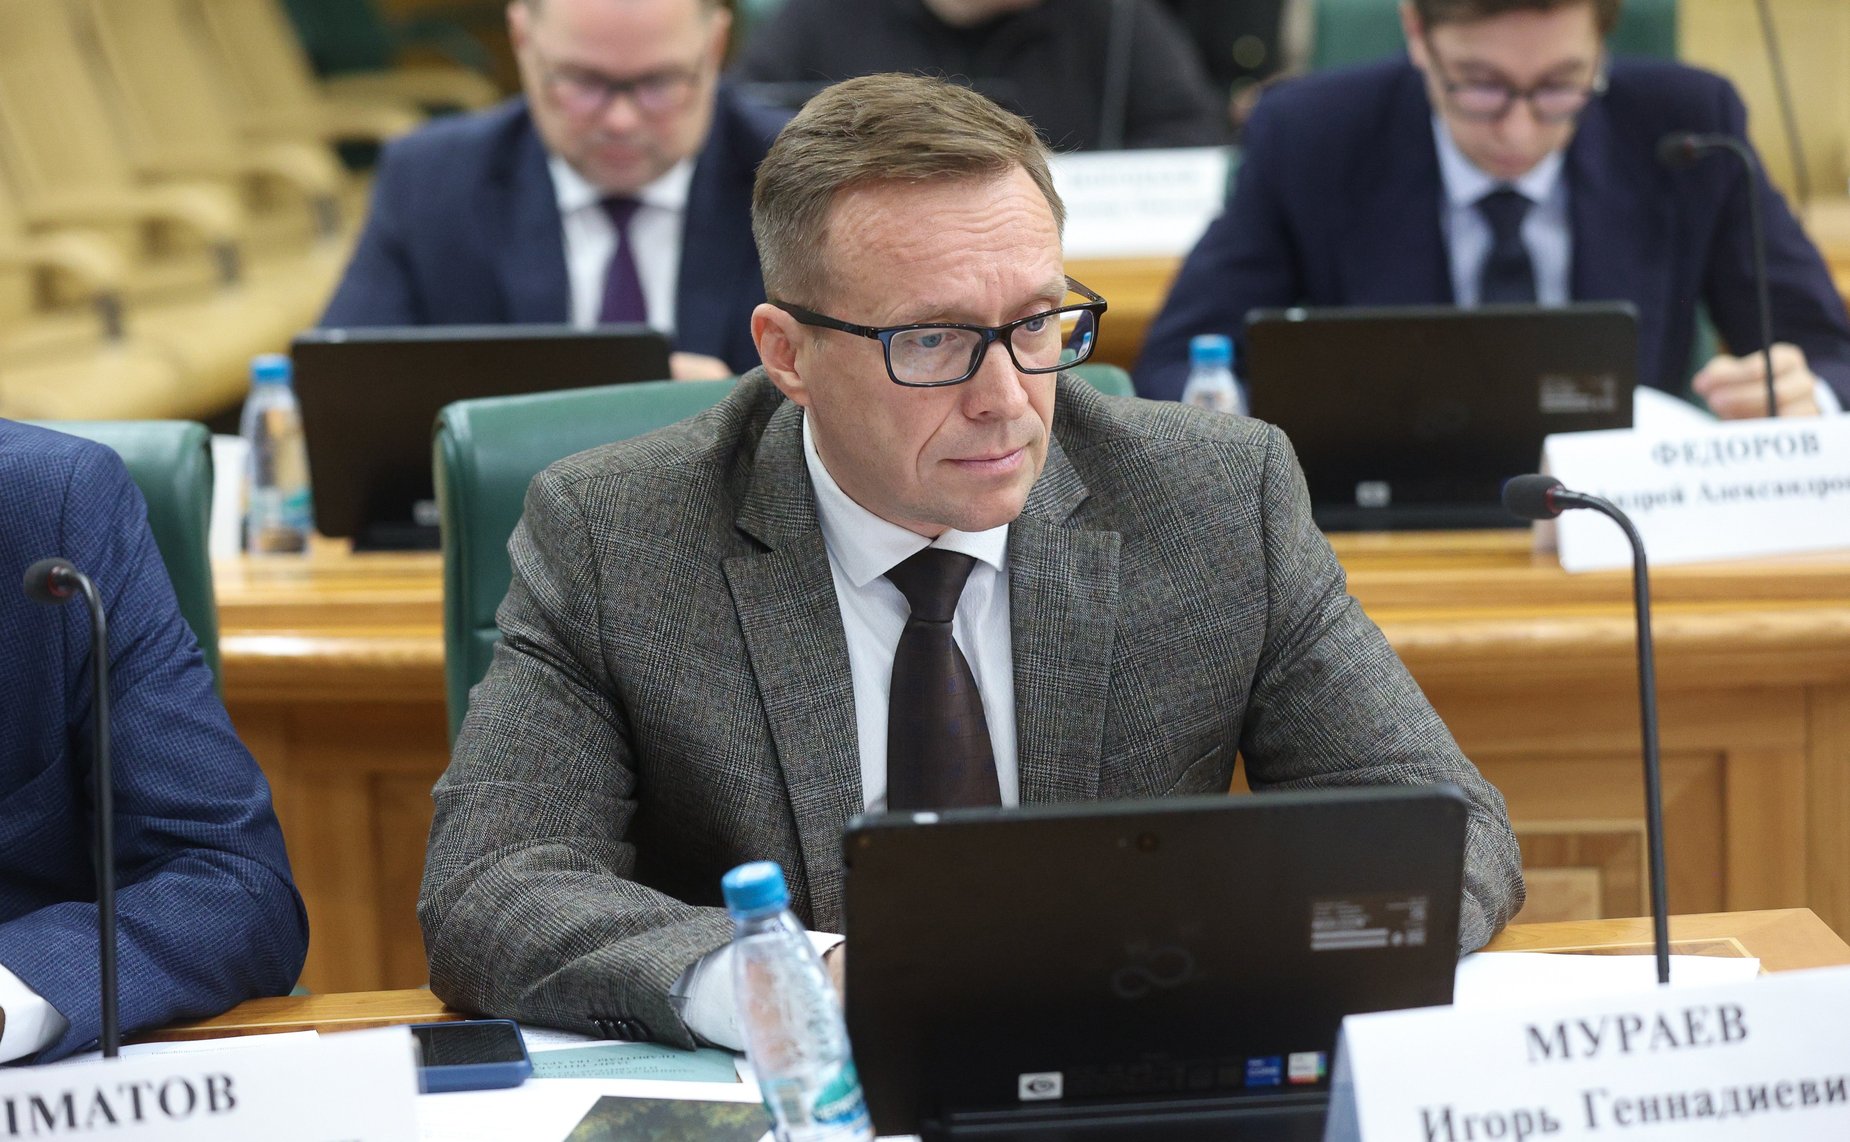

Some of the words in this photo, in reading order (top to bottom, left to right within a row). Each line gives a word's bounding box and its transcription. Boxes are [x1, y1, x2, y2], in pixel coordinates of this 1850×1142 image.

[1650, 429, 1821, 467] ФЕДОРОВ
[1524, 1002, 1750, 1062] МУРАЕВ
[1420, 1104, 1561, 1142] Игорь
[1581, 1076, 1848, 1130] Геннадиеви
